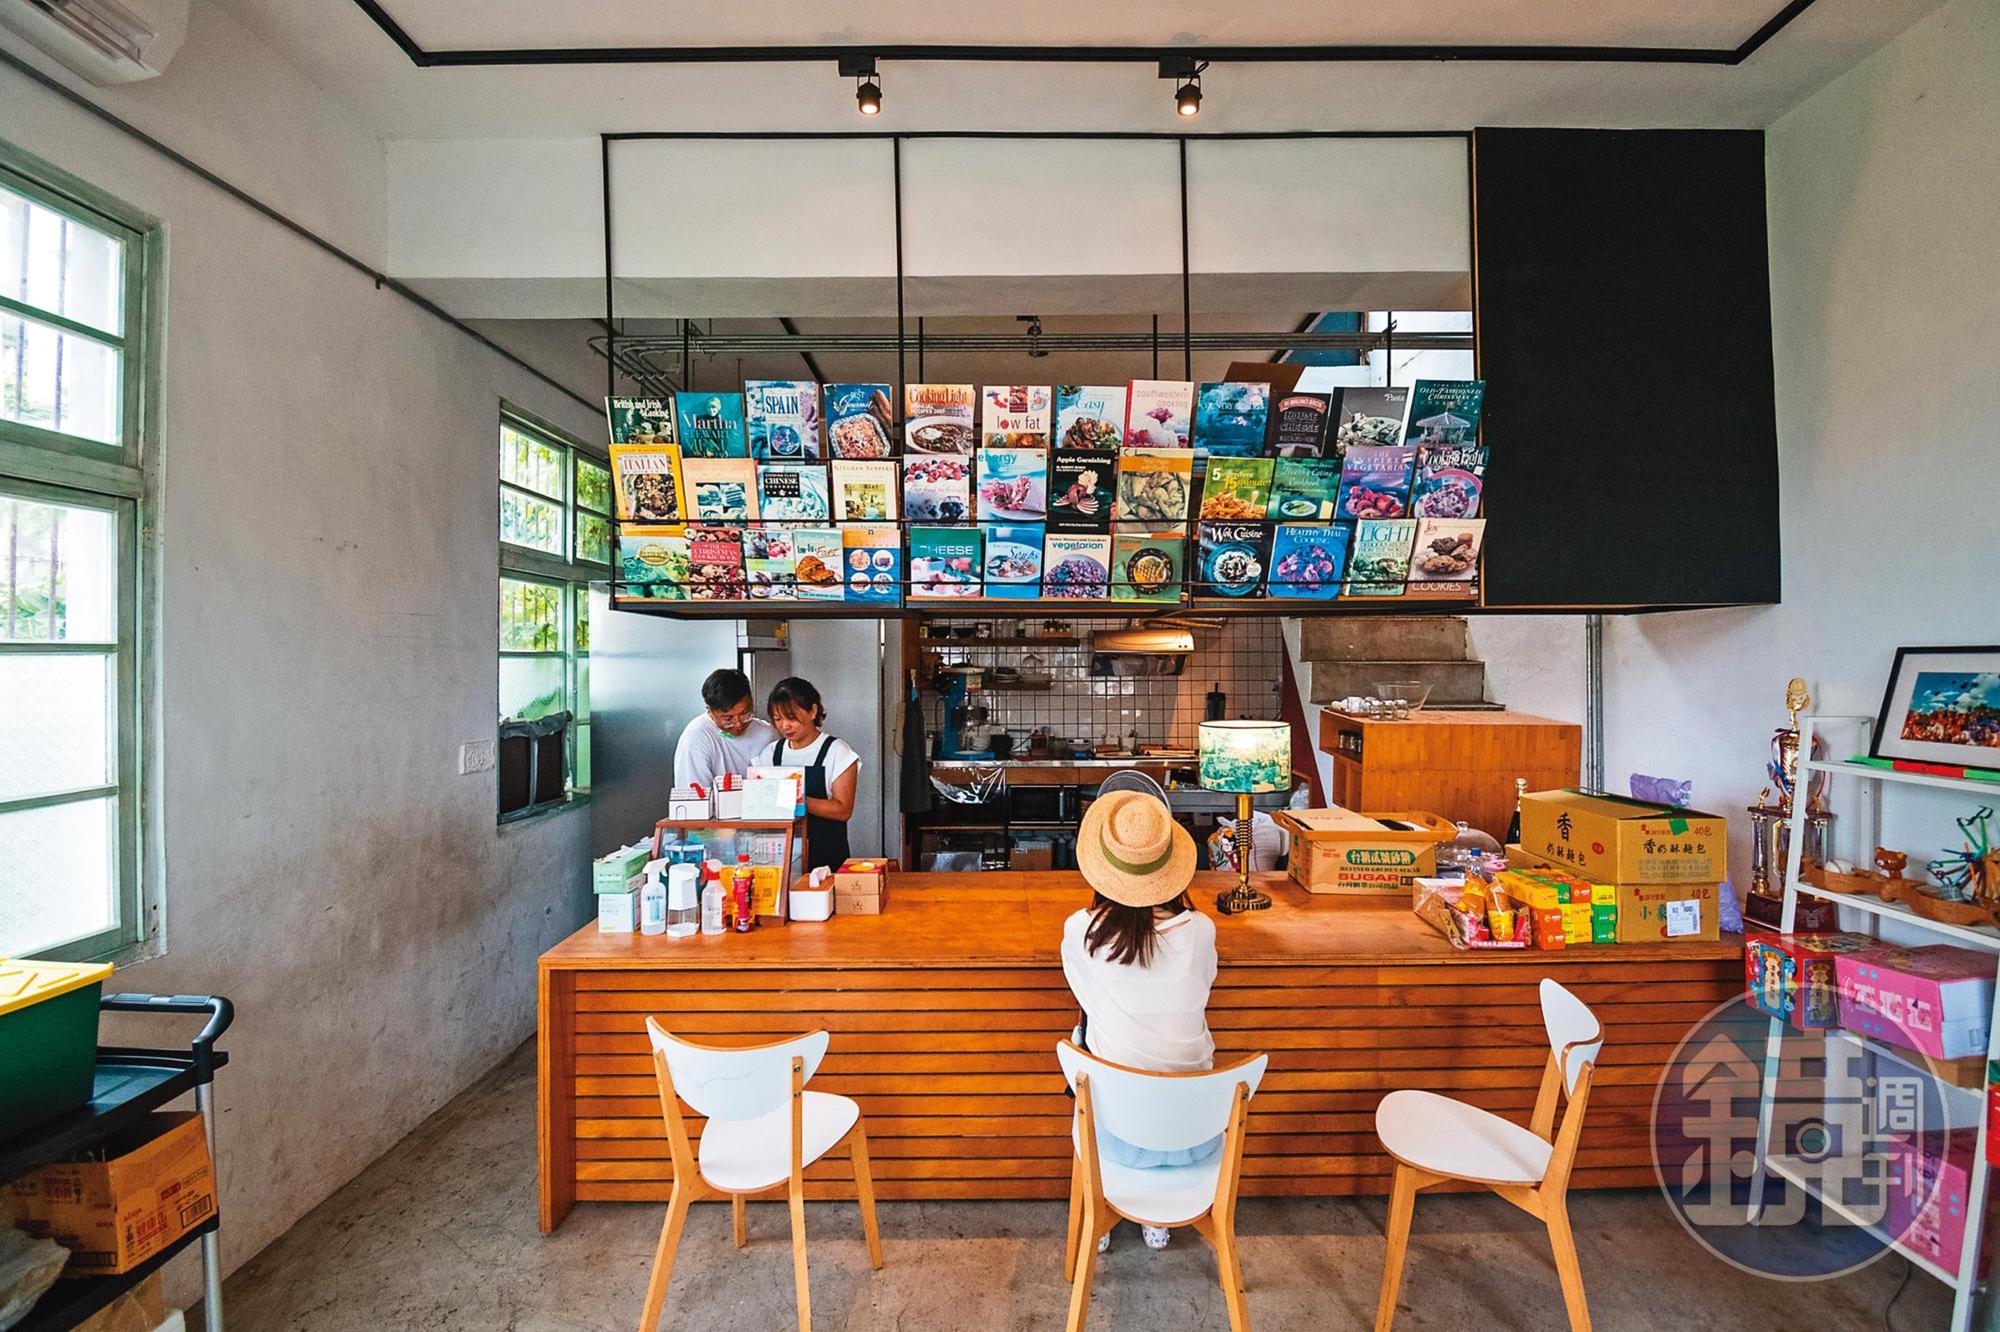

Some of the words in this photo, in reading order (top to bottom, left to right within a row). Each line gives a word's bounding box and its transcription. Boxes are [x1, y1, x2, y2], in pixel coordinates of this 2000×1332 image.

[1428, 393, 1471, 401] CHRISTMAS
[765, 396, 799, 414] SPAIN
[682, 412, 738, 430] Martha
[1025, 415, 1041, 429] fat
[624, 459, 667, 470] ITALIAN
[1347, 463, 1411, 471] VEGETARIAN
[1212, 468, 1222, 481] 5
[1223, 476, 1238, 490] 15
[1233, 527, 1264, 541] Cuisine
[1359, 526, 1415, 542] LIGHT
[919, 545, 974, 555] CHEESE
[1052, 542, 1104, 551] vegetarian
[1412, 581, 1462, 592] COOKIES
[1557, 811, 1573, 842] 香
[1337, 873, 1399, 882] SUGAR
